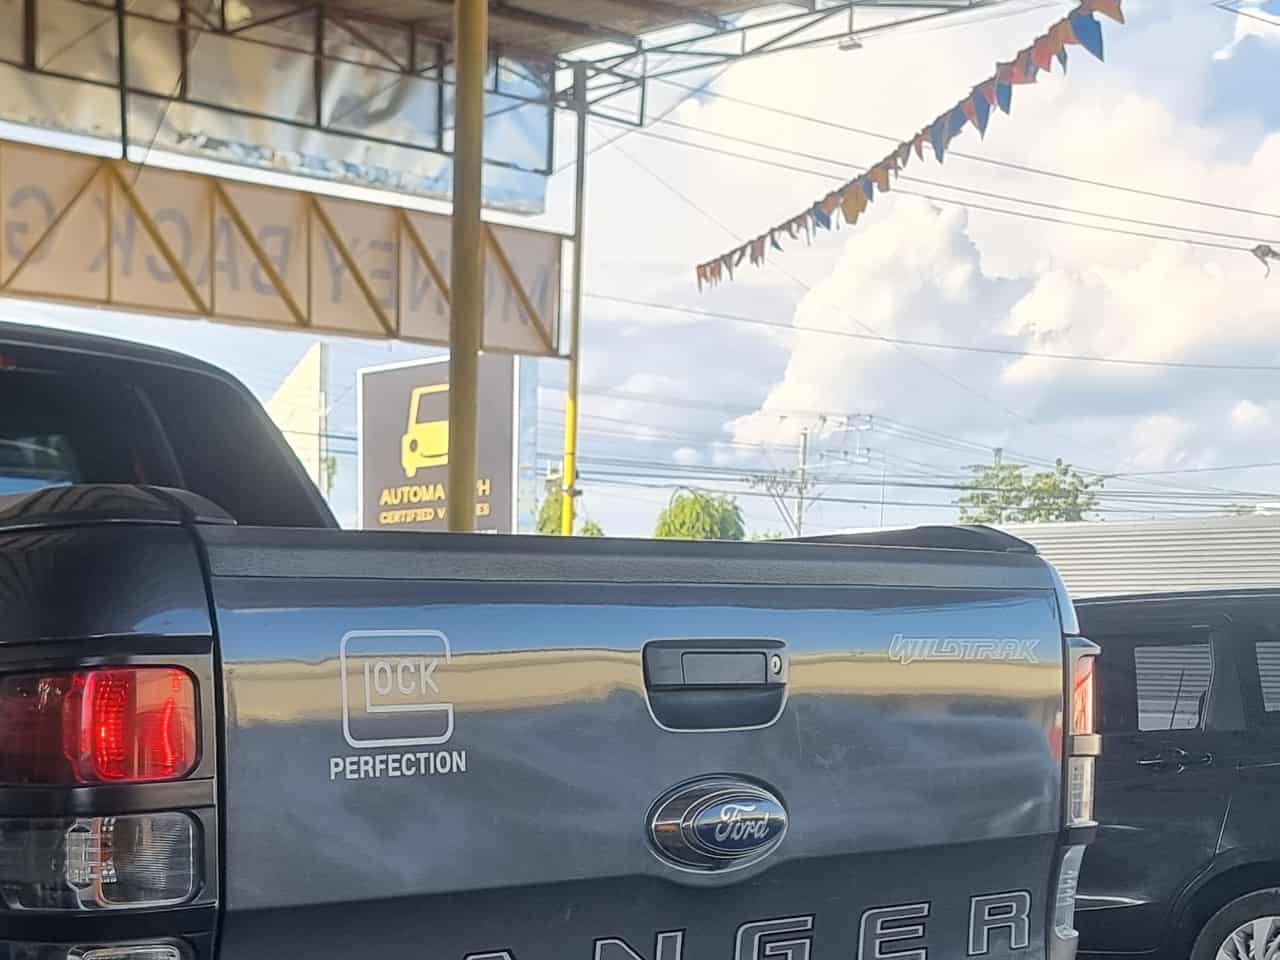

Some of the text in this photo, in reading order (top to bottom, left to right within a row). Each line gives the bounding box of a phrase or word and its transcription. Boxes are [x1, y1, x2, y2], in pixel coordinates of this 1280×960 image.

[888, 633, 1041, 664] WILDTRAK
[329, 750, 467, 780] PERFECTION
[714, 804, 770, 842] Ford
